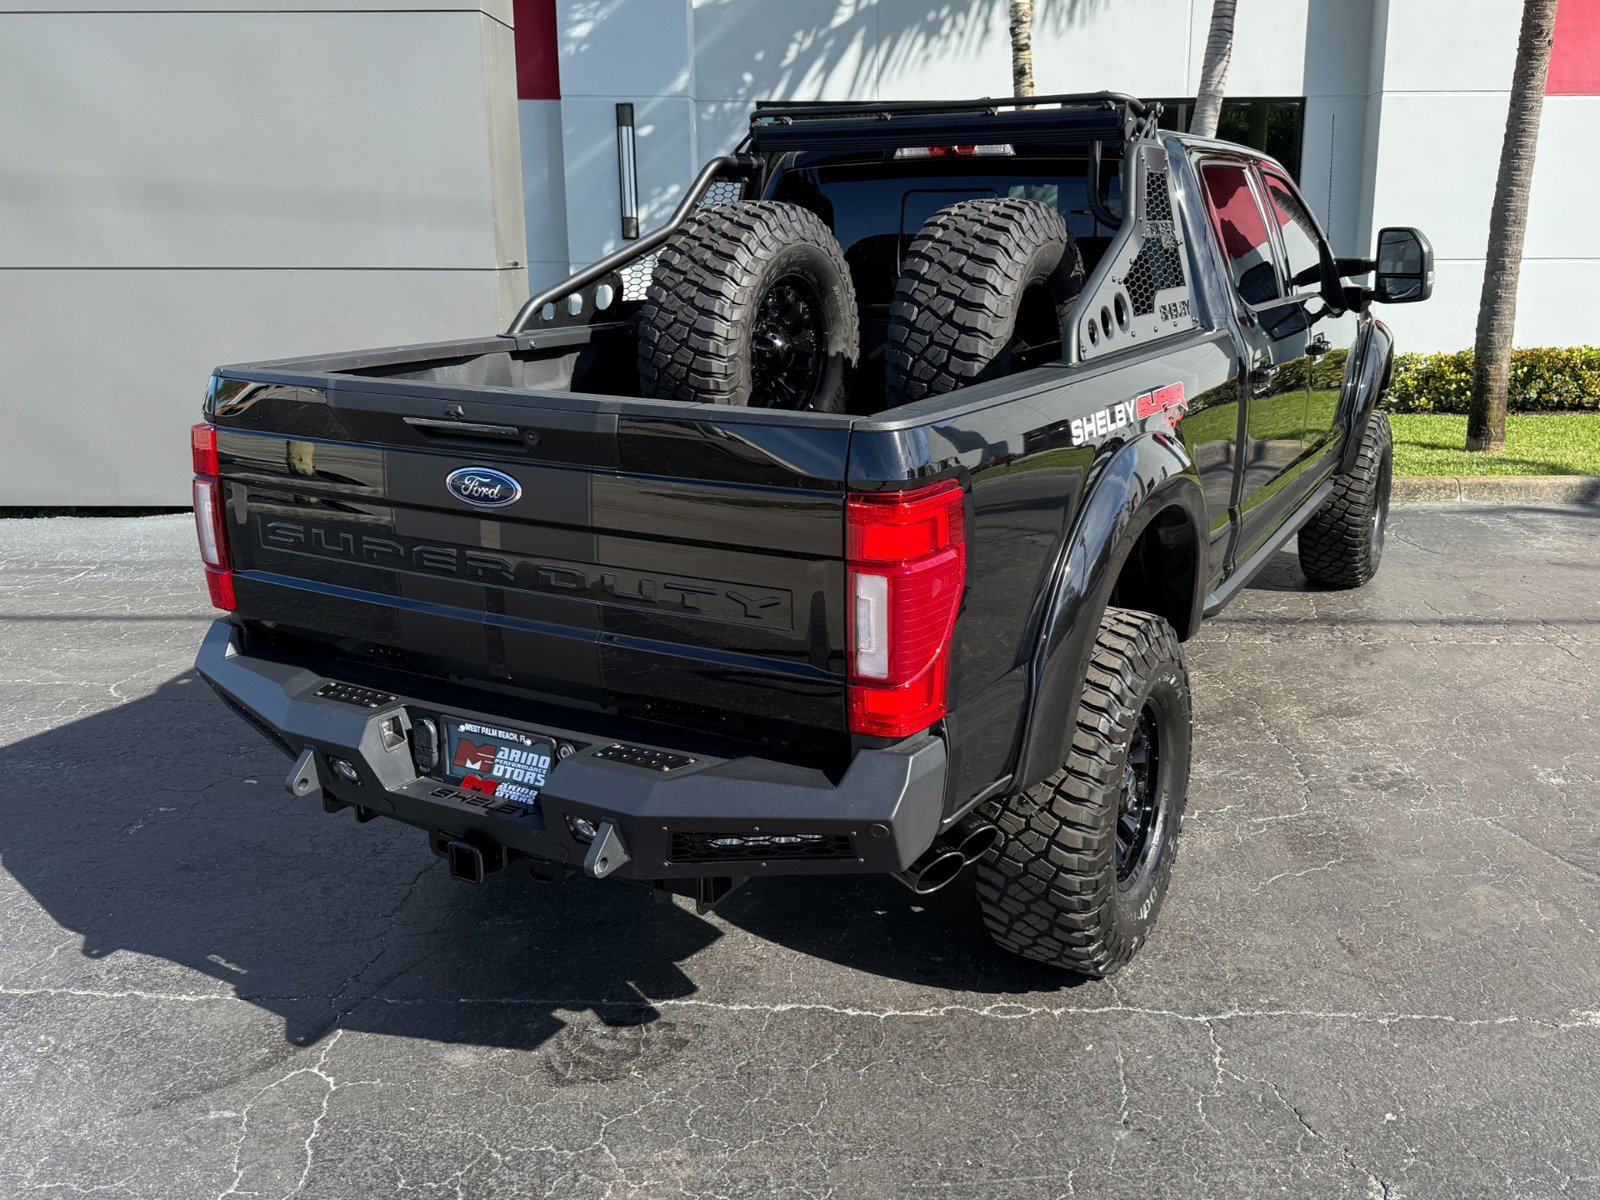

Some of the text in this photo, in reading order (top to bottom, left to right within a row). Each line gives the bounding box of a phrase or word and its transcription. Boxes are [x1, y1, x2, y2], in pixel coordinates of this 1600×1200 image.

[1070, 399, 1135, 446] SHELBY
[460, 475, 503, 500] Ford
[266, 521, 783, 619] SUPER DUTY
[464, 722, 480, 733] WEST
[481, 726, 498, 737] PALM
